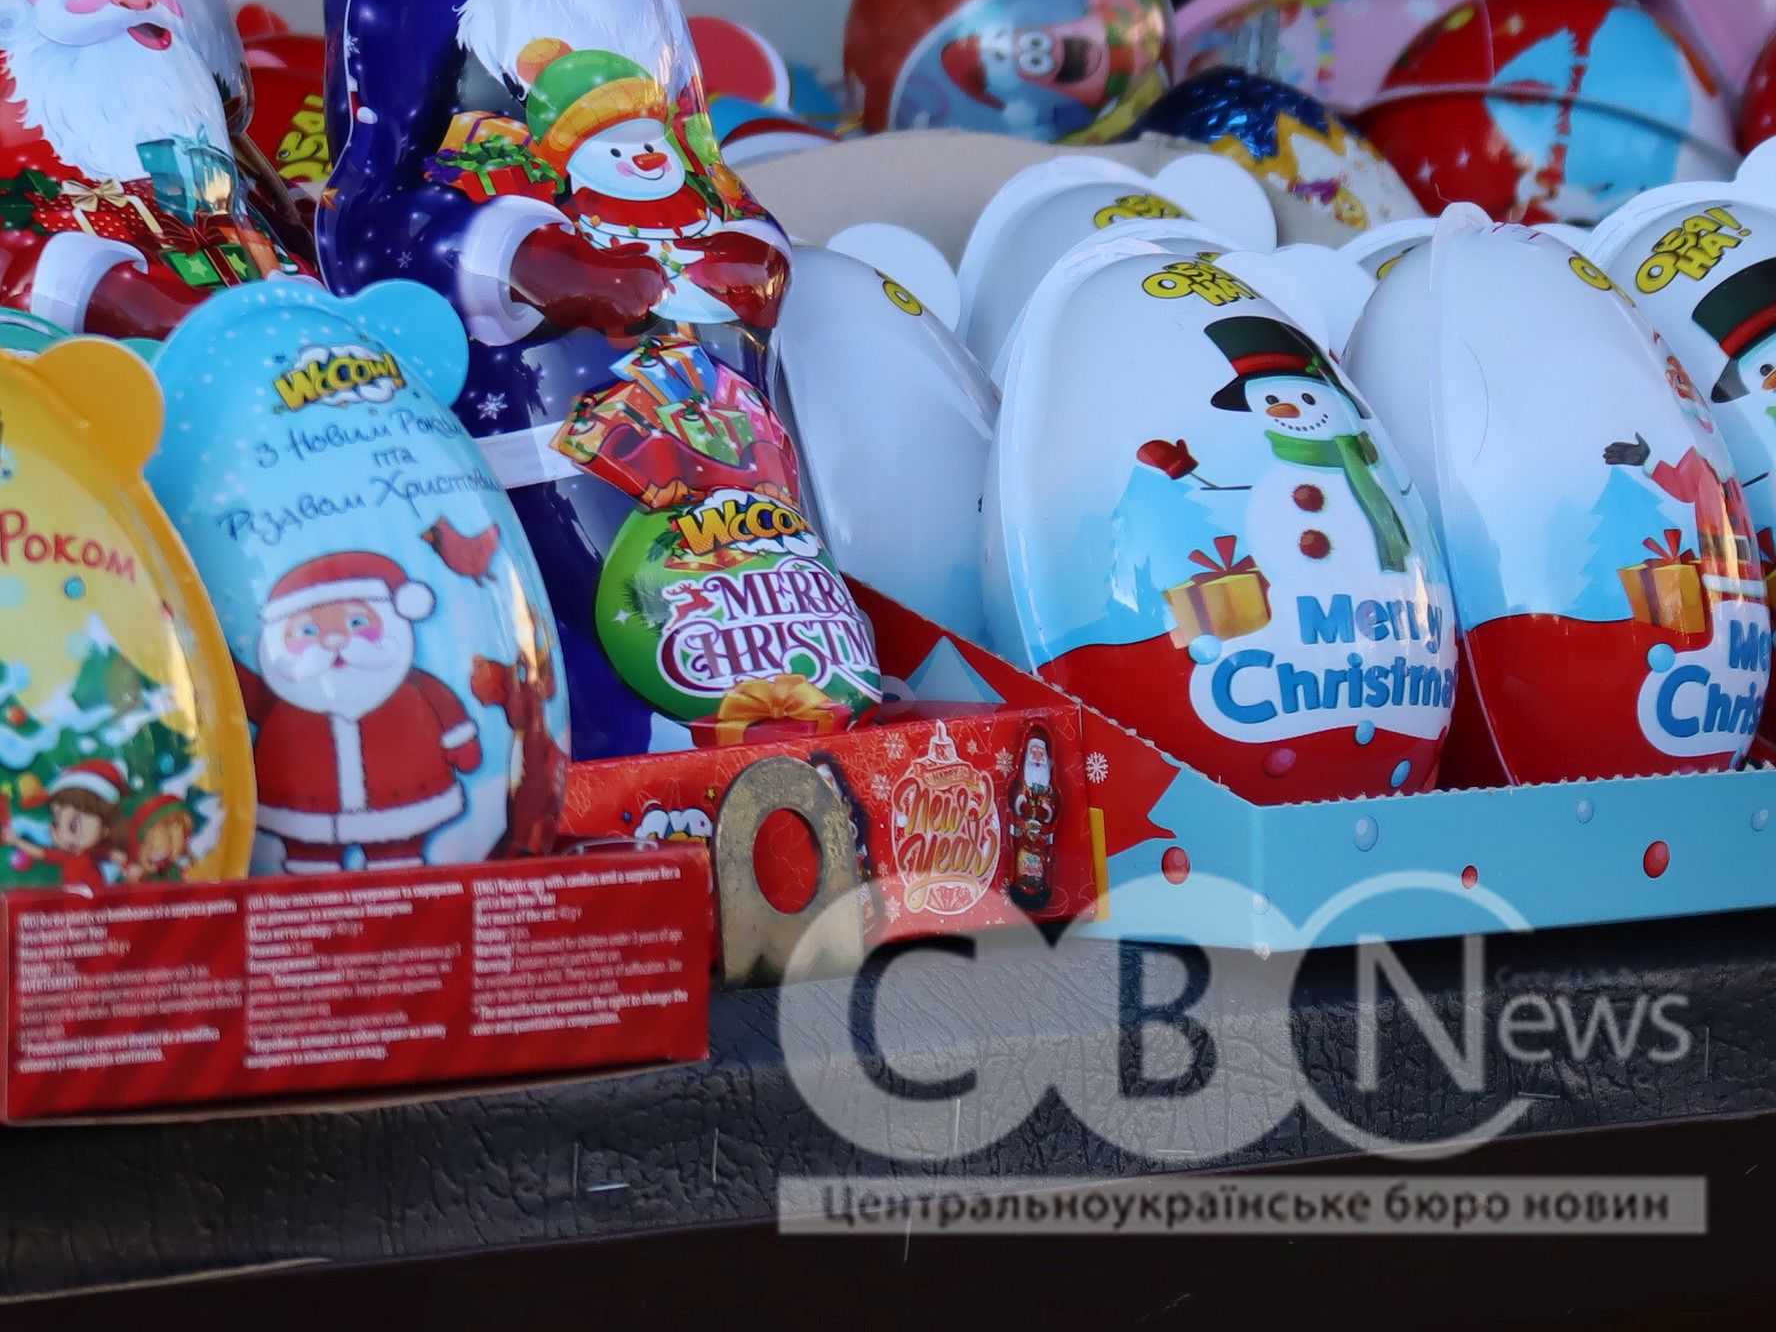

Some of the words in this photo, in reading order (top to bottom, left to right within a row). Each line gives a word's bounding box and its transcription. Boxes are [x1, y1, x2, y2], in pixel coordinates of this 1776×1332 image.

[286, 421, 393, 462] Новим
[370, 445, 418, 471] та
[1295, 593, 1443, 654] Merry
[1729, 619, 1772, 672] Me
[660, 619, 884, 698] CHRISTM
[1210, 648, 1458, 724] Christma
